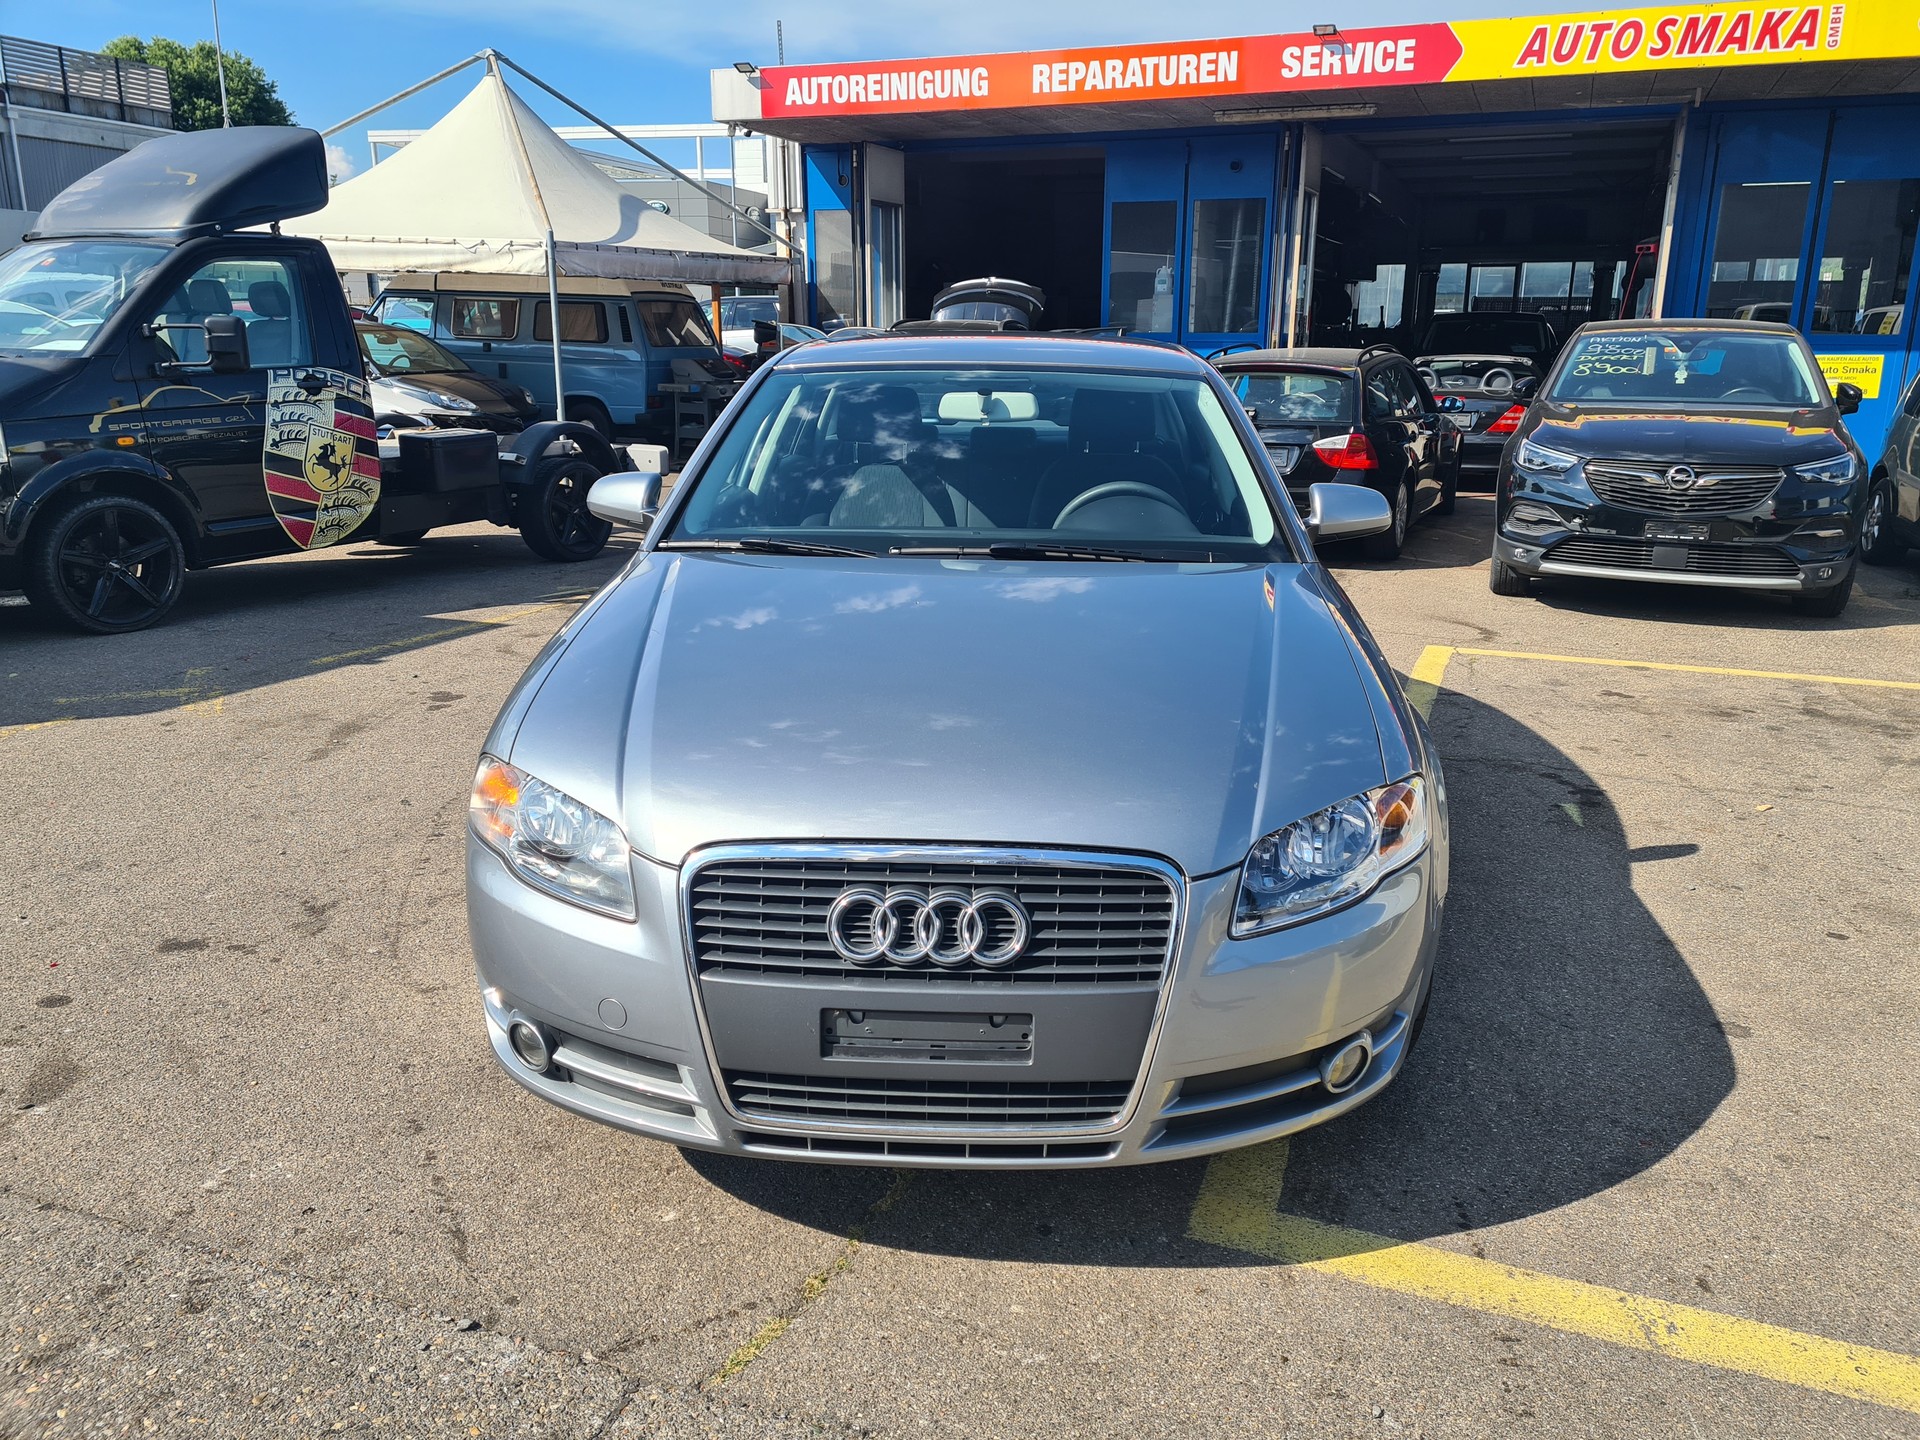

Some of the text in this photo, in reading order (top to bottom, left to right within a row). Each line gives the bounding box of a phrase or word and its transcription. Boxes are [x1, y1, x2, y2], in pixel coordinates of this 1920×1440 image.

[1515, 5, 1844, 67] AUTO SMAKA GMBH
[1032, 50, 1239, 94] REPARATUREN
[1281, 39, 1416, 79] SERVICE
[784, 66, 989, 106] AUTOREINIGUNG
[1821, 365, 1877, 374] uto Smaka
[108, 416, 222, 432] SPORTGARAGE
[158, 434, 201, 443] PORSCHE
[202, 430, 249, 440] SPEZIALIST
[311, 427, 352, 445] STUTTGART
